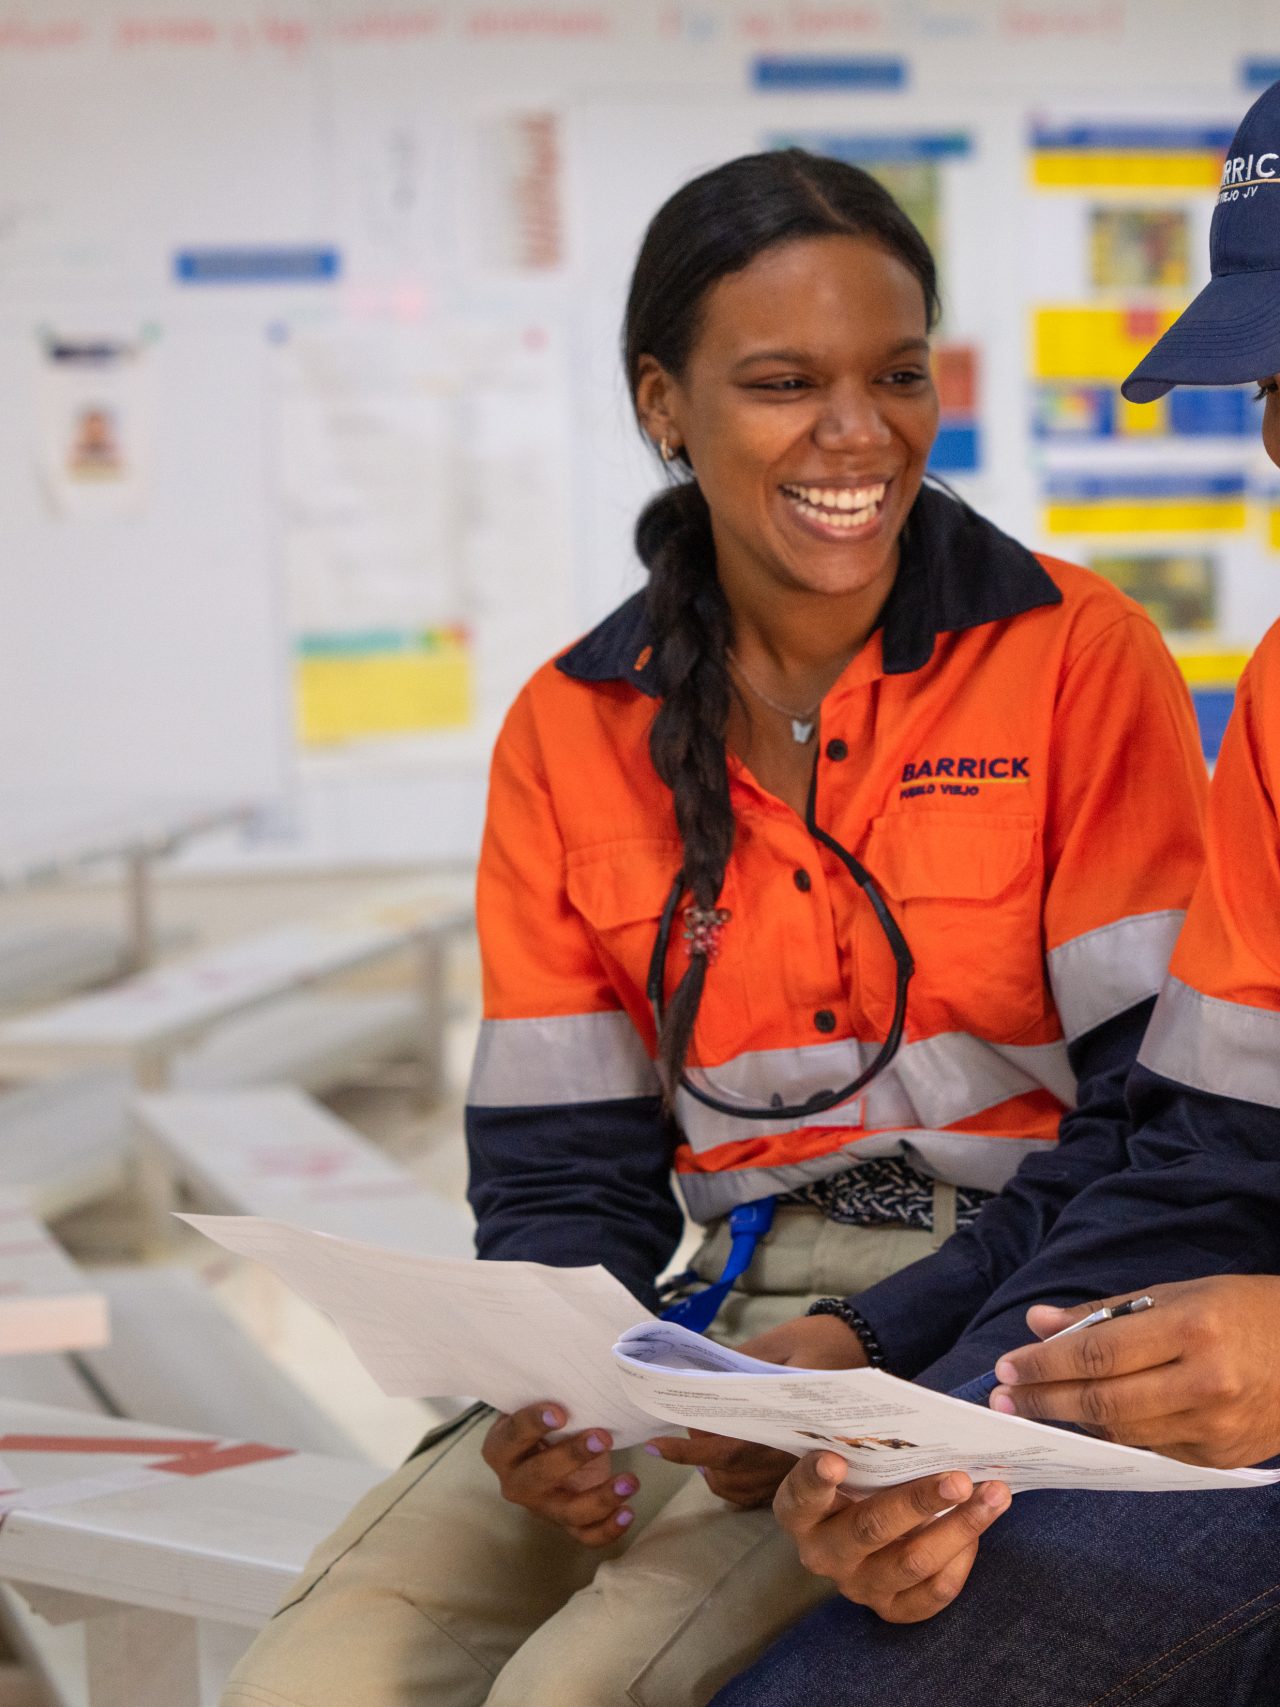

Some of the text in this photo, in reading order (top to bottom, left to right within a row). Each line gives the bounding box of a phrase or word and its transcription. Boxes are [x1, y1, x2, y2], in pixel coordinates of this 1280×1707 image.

[1242, 185, 1259, 199] JV
[902, 757, 1030, 783] BARRICK
[940, 784, 979, 796] VIEJO
